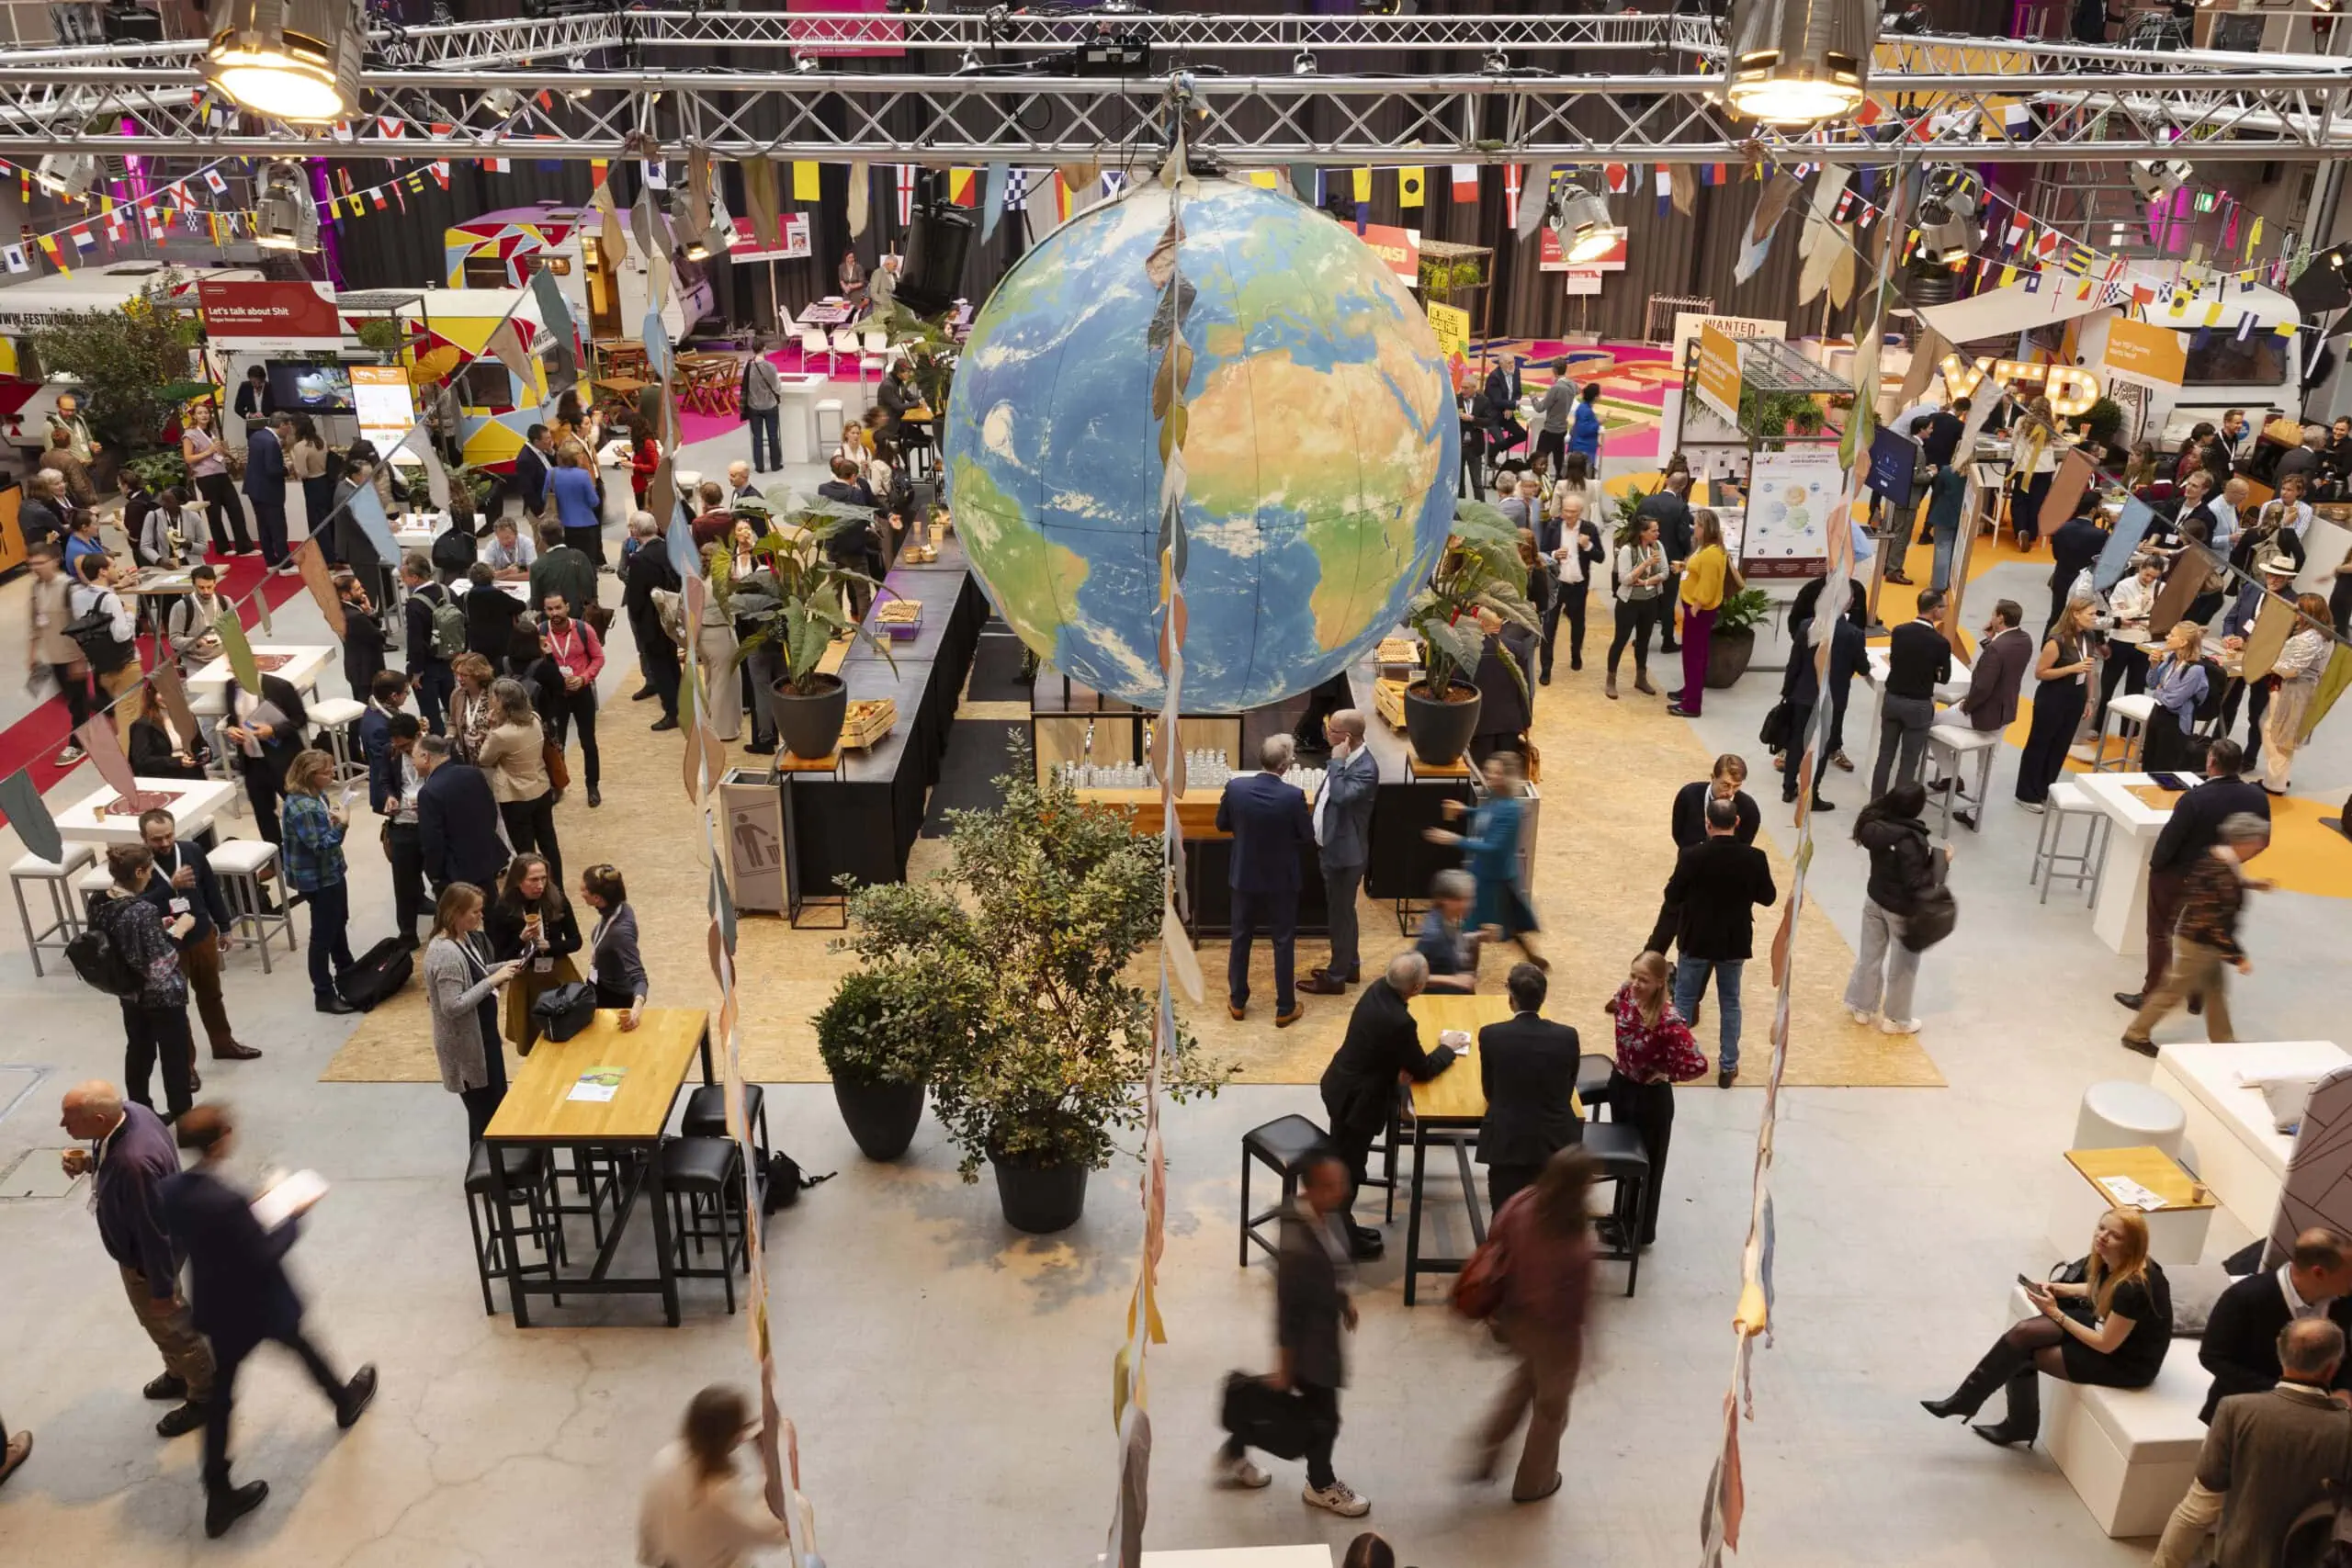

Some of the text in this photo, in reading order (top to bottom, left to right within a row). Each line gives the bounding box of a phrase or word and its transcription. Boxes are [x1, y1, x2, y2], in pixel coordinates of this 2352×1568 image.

[208, 306, 290, 317] Let's talk about Shit
[1705, 319, 1757, 338] WANTED
